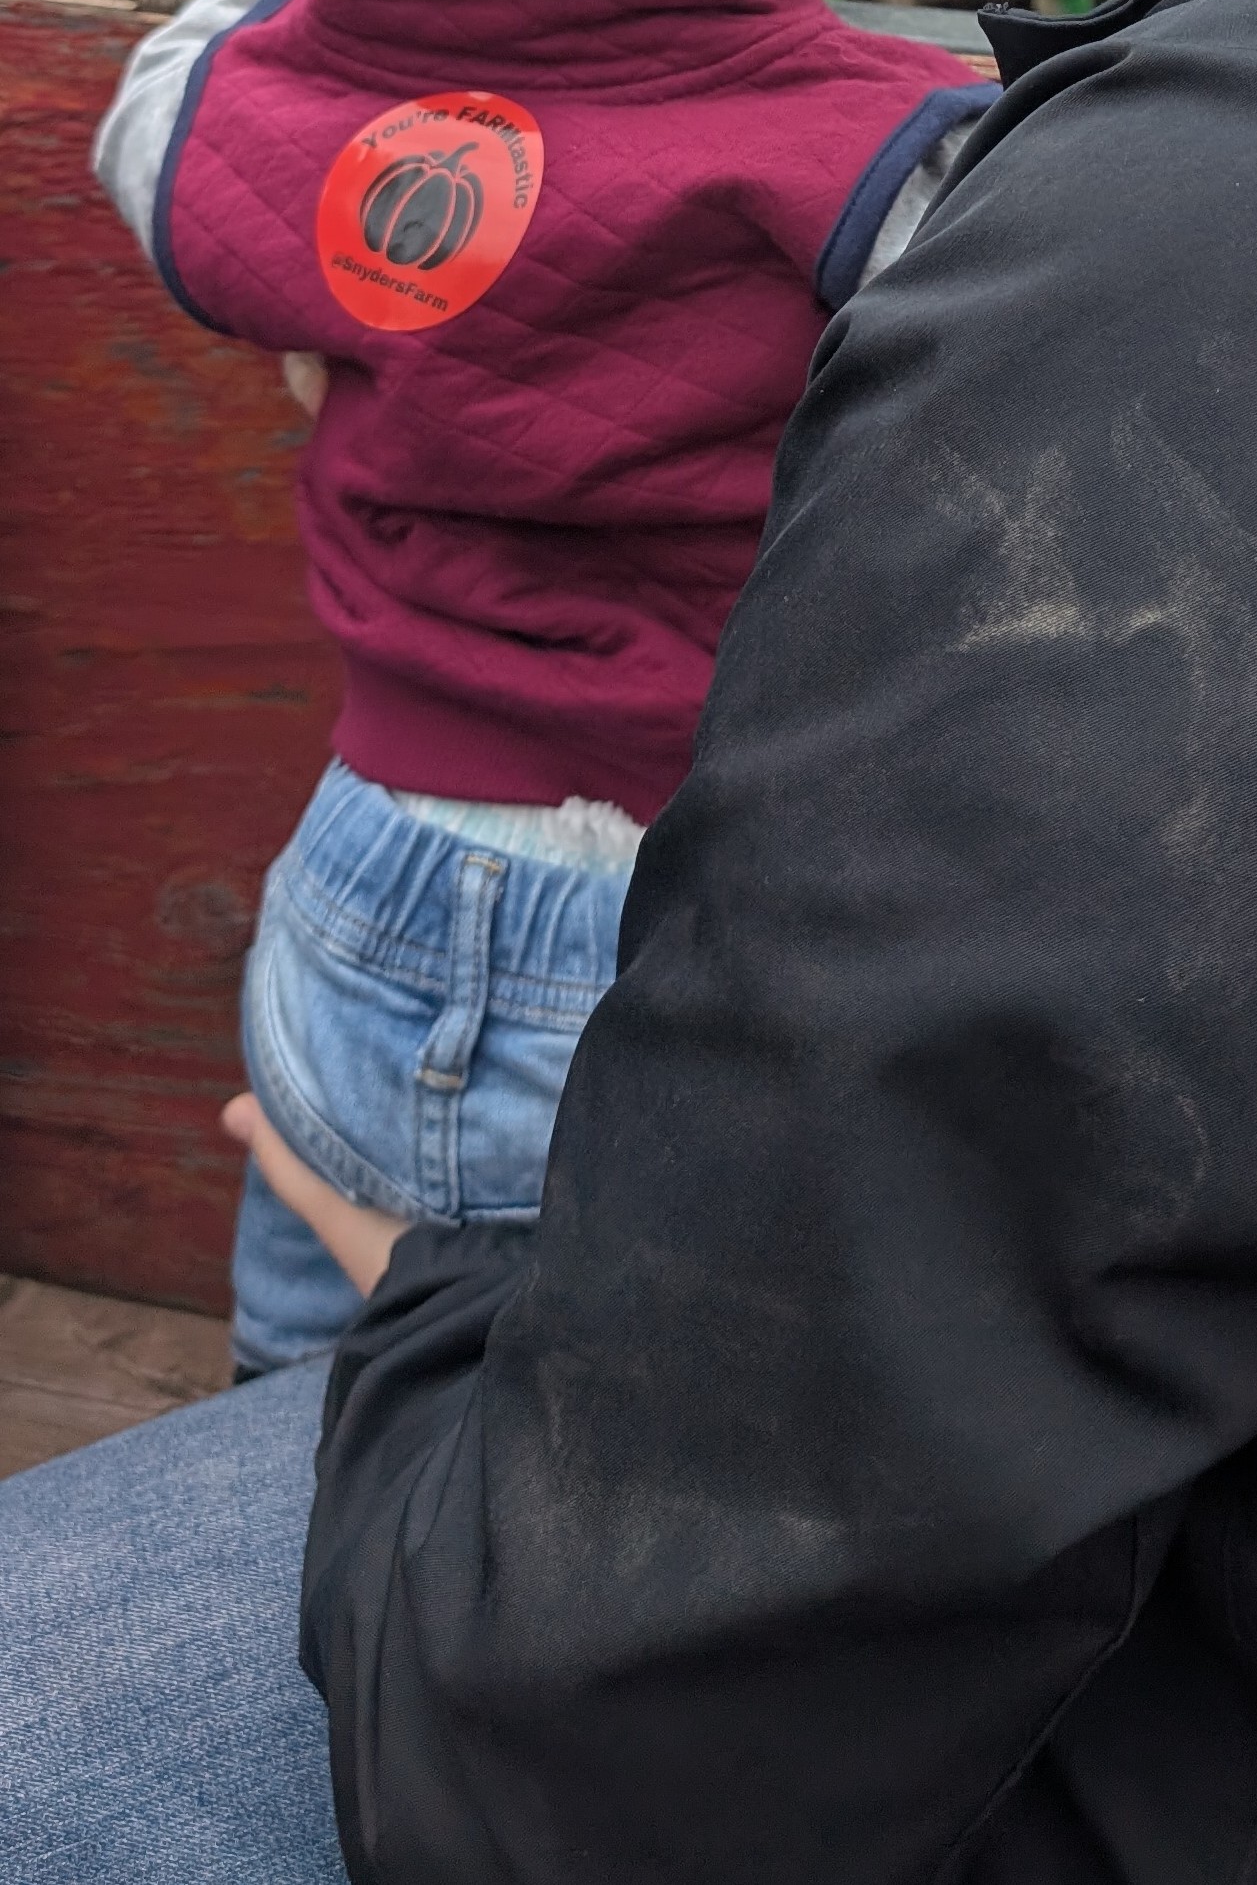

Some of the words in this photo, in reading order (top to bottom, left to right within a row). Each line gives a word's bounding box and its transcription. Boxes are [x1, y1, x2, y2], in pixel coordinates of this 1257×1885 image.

[362, 109, 449, 149] You're
[455, 106, 534, 209] FARMtastic
[332, 252, 449, 312] @SnydersFarm
